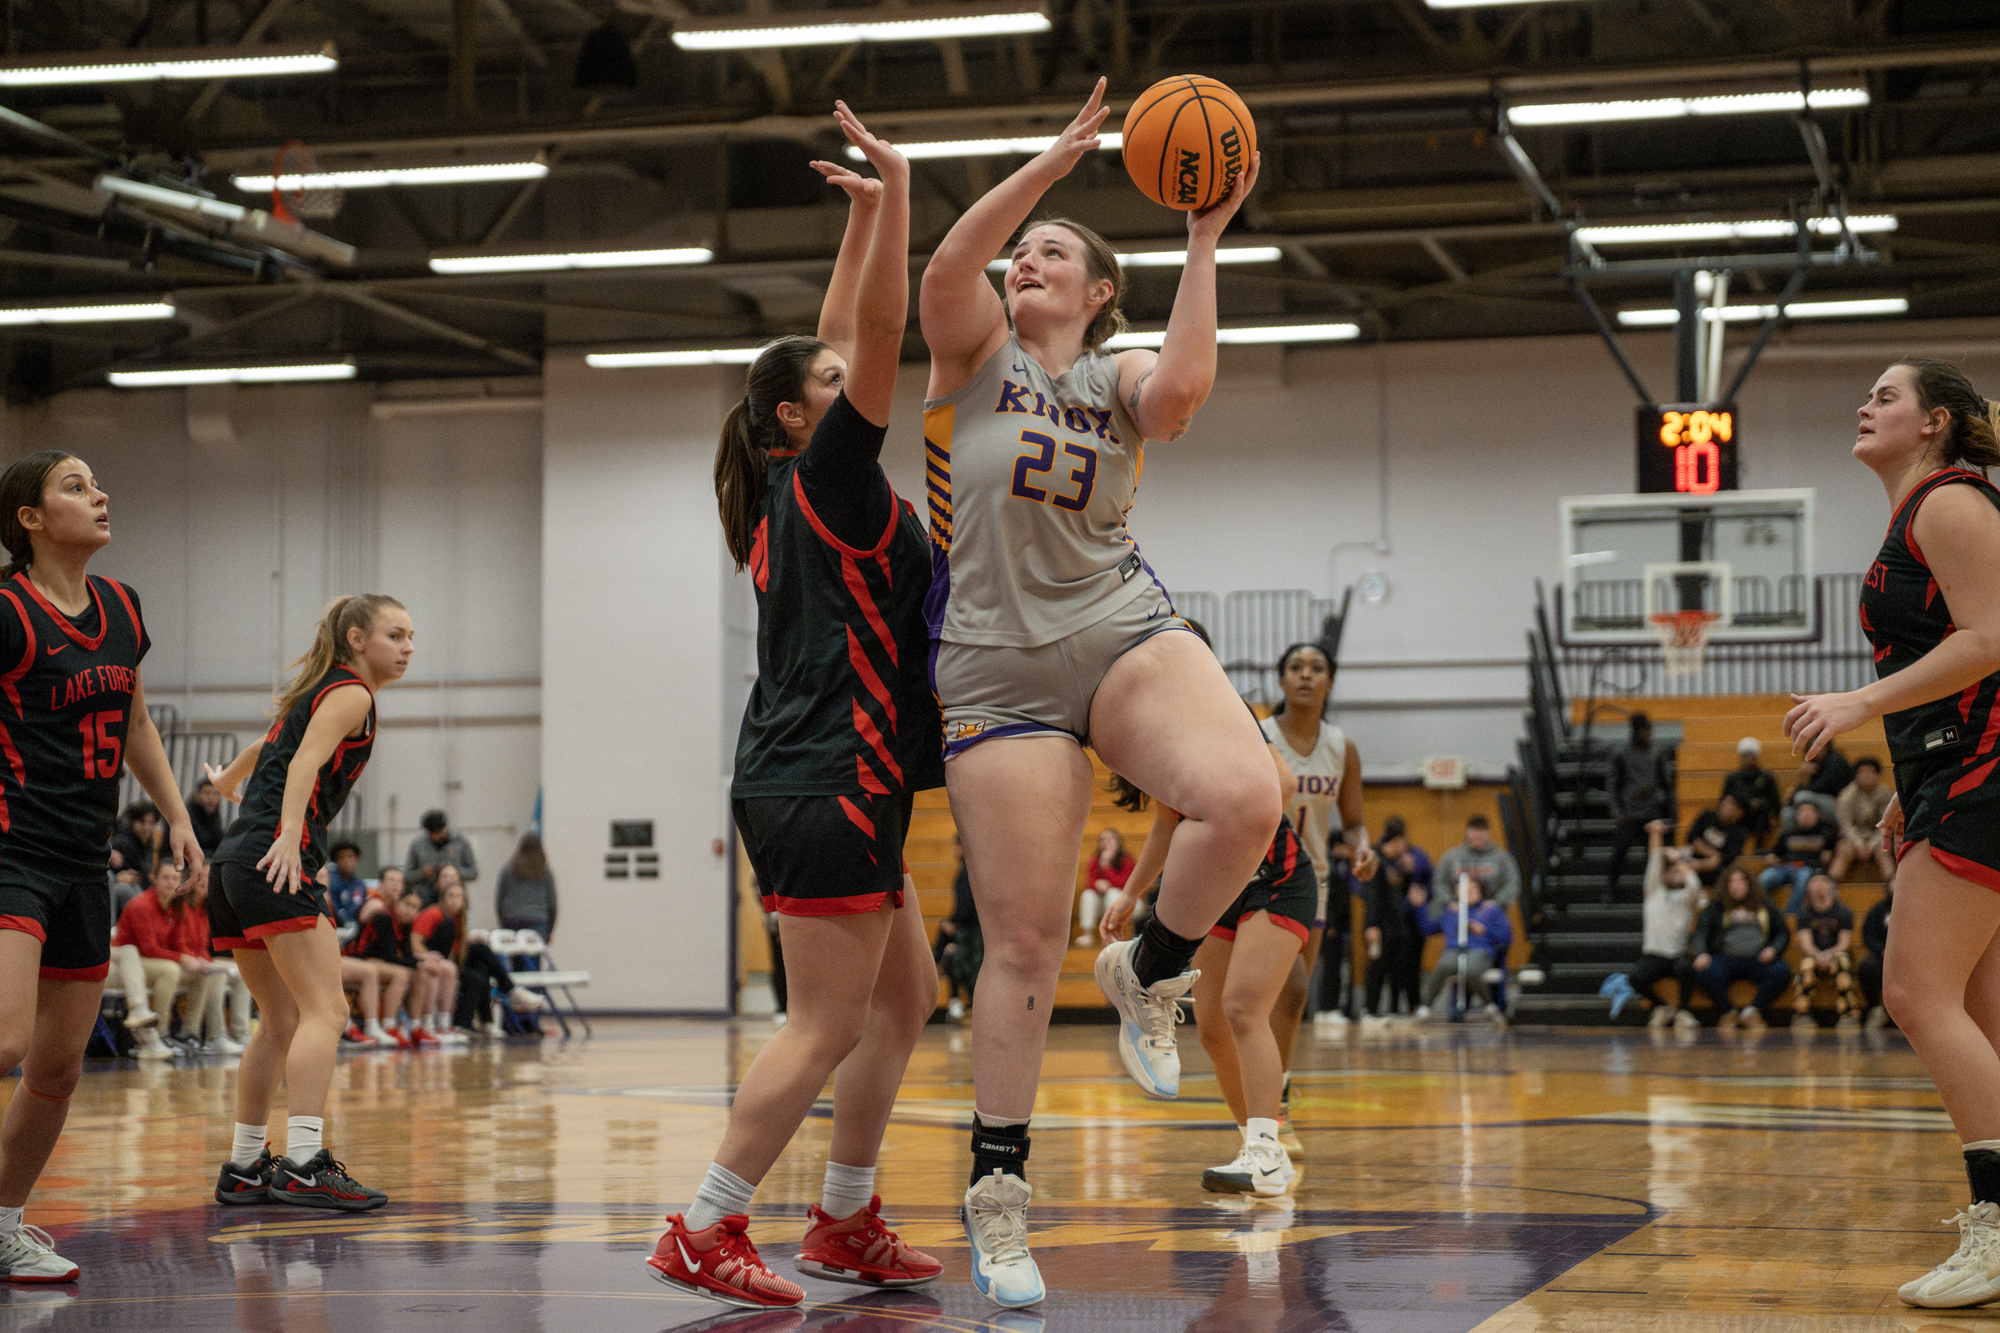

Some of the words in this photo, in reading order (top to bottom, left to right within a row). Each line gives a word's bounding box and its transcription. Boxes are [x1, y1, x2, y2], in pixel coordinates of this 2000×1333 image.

[1177, 149, 1200, 203] NCAA
[1219, 125, 1243, 201] Wilso
[994, 379, 1122, 446] KNOX
[1660, 410, 1732, 448] 2:04
[1010, 429, 1098, 513] 23
[1675, 441, 1720, 496] 10
[1863, 558, 1889, 593] EST
[51, 668, 97, 711] LAKE
[96, 664, 137, 696] FORES
[78, 709, 123, 780] 15
[1946, 730, 1955, 740] M
[1297, 774, 1338, 797] OX
